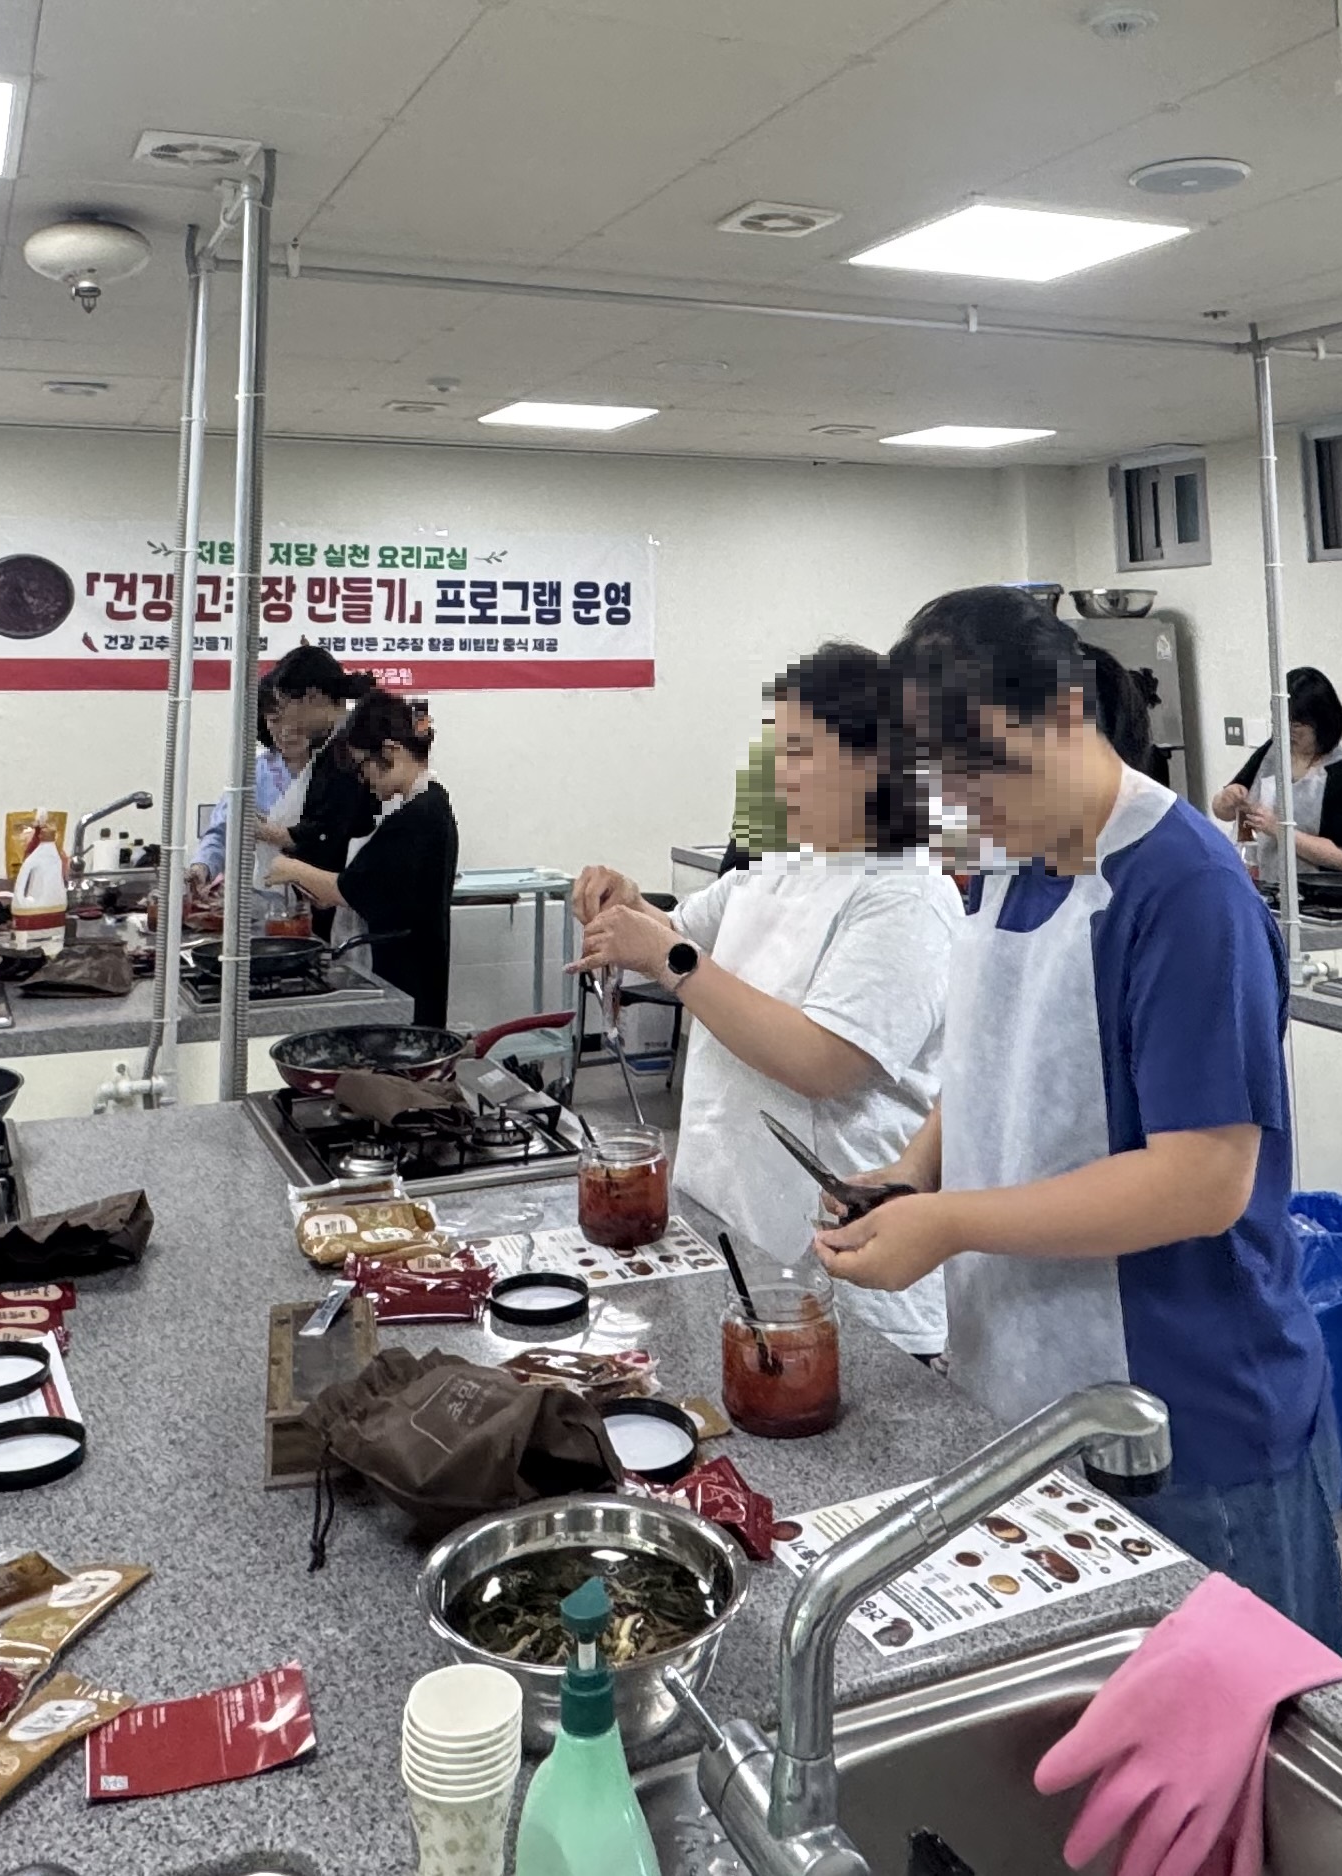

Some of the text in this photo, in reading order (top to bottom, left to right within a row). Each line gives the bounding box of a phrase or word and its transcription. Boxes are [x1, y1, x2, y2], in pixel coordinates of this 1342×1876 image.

[268, 542, 319, 567] 저당
[323, 543, 371, 569] 실천
[377, 545, 468, 571] 요리교실
[195, 574, 297, 624] 고장
[435, 579, 562, 625] 프로그램
[572, 580, 632, 626] 운영
[103, 634, 136, 651] 건강
[138, 635, 182, 651] 고추
[350, 636, 379, 652] 만든
[381, 636, 424, 652] 고추장
[427, 636, 455, 652] 활용
[458, 637, 500, 652] 비빔밥
[532, 637, 559, 653] 제공
